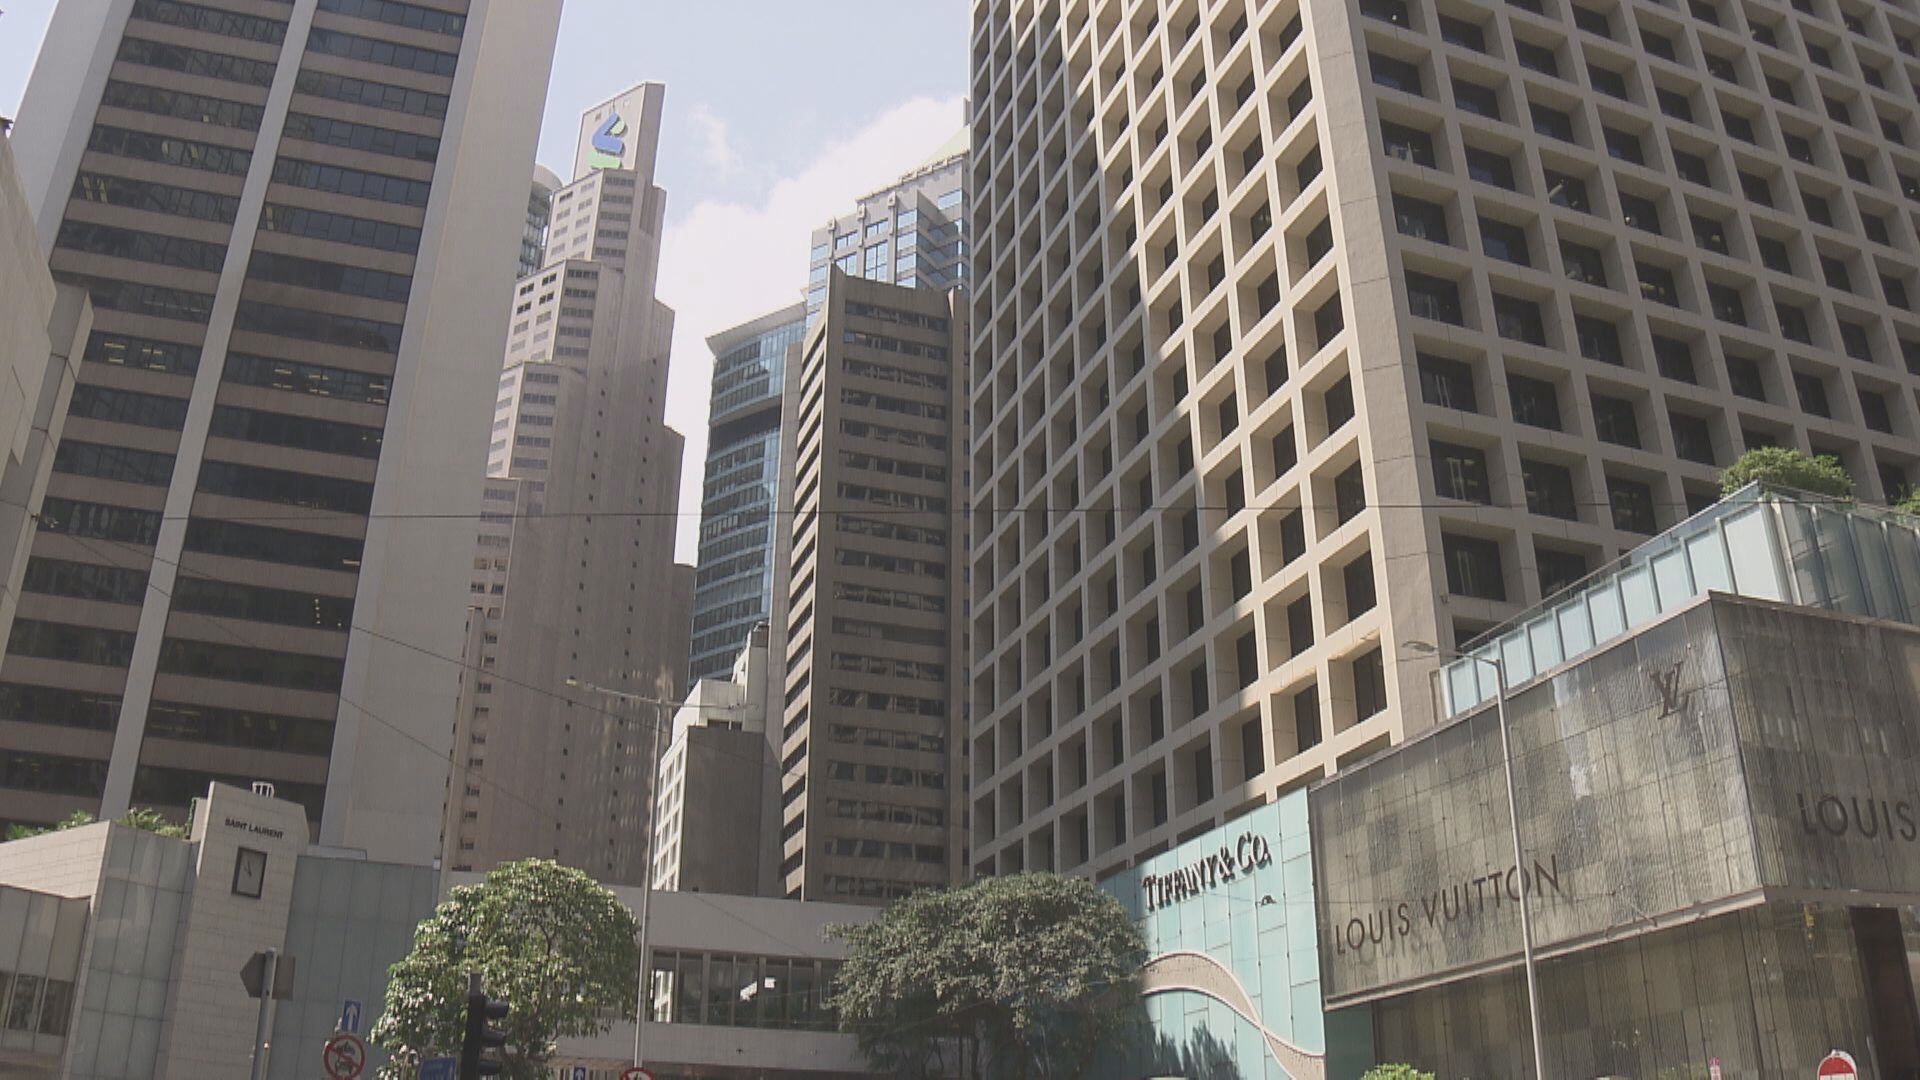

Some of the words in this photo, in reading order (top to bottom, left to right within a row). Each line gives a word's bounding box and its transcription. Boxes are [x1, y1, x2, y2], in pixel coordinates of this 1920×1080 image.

[225, 818, 247, 829] SAINT
[249, 824, 283, 838] LAURENT
[1798, 793, 1917, 841] LOUIS
[1336, 902, 1410, 955] LOUIS
[1421, 854, 1560, 928] VUITTON
